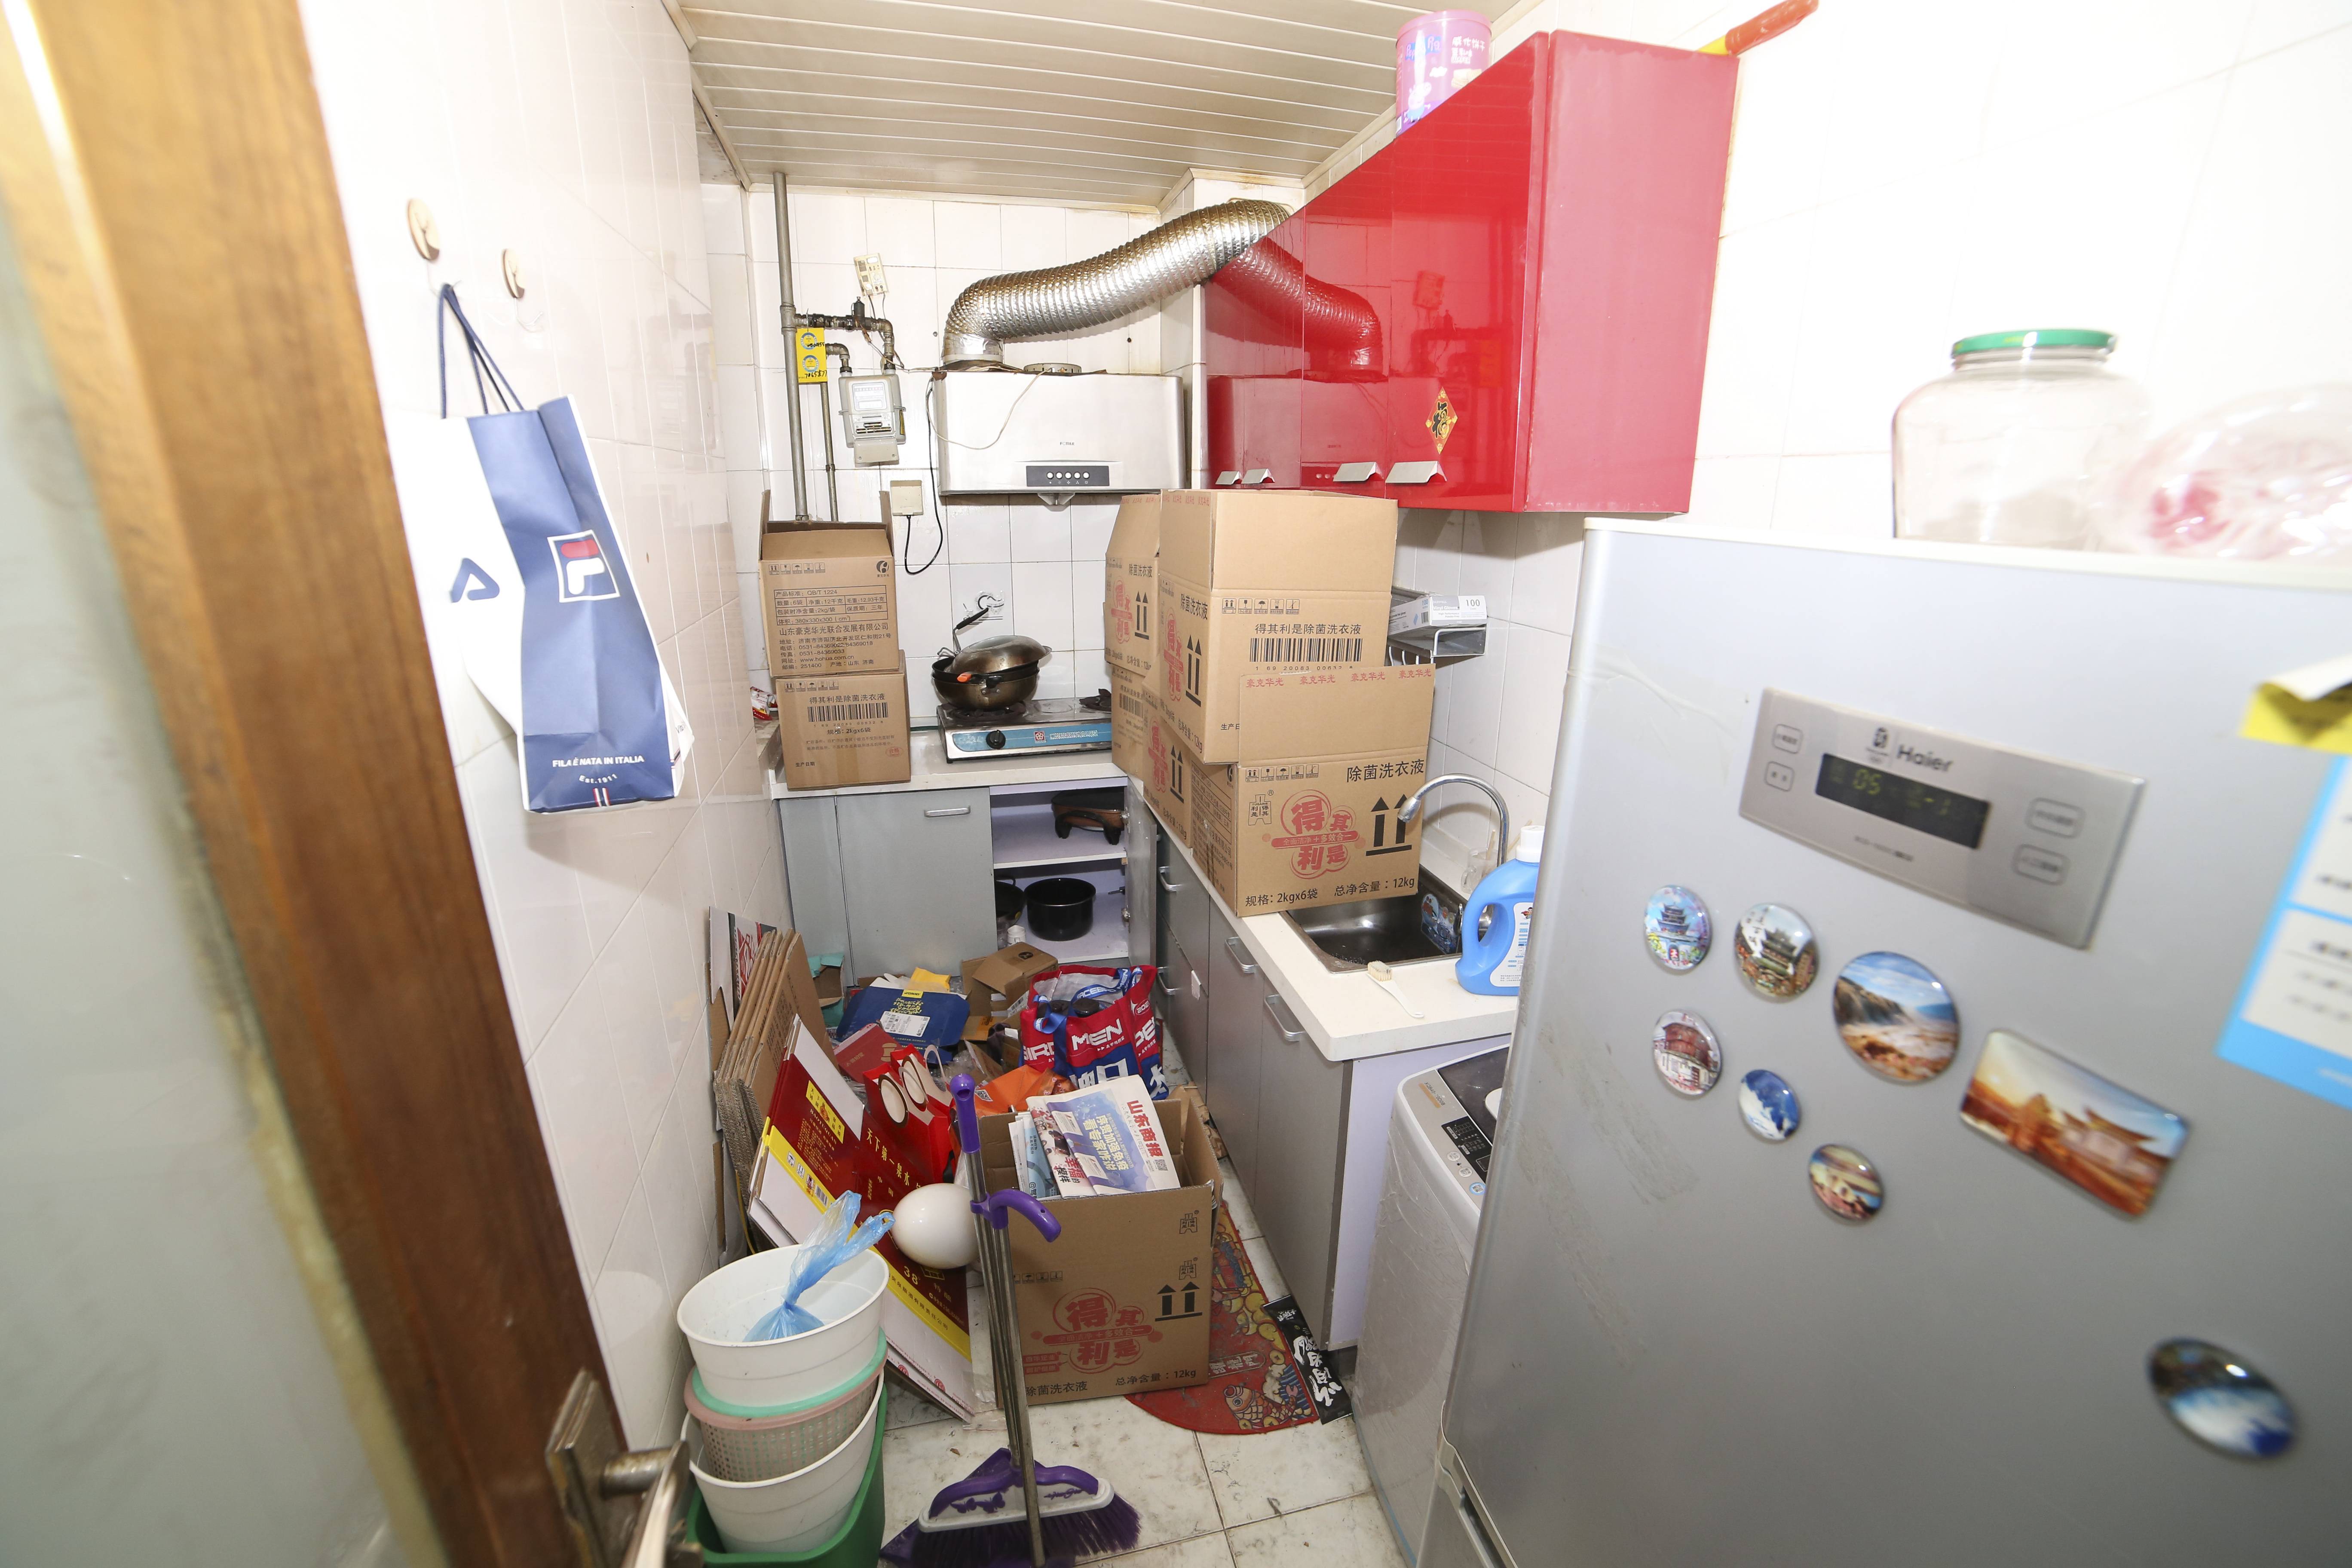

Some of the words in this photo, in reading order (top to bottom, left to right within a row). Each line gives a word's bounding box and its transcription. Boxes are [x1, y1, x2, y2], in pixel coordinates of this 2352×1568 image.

[1129, 564, 1152, 578] 除菌洗衣液
[1181, 594, 1208, 620] 除菌洗衣液
[779, 623, 888, 636] 山东豪克华光联合发展有限公司
[1255, 623, 1362, 635] 得其利是除菌洗衣液
[1246, 678, 1284, 688] 豪克华光
[1299, 674, 1335, 685] 豪克华光
[1351, 671, 1386, 682] 豪克华光
[1399, 668, 1432, 679] 豪克华光
[809, 693, 885, 704] 得其利是除菌洗衣液
[552, 760, 572, 768] FILA
[573, 757, 579, 766] È
[579, 757, 603, 766] NATA
[615, 755, 644, 764] ITALIA
[1896, 744, 1954, 772] Haier
[579, 774, 618, 784] Est.1911
[1347, 759, 1424, 783] 除菌洗衣液
[1072, 1018, 1123, 1051] MEN
[1127, 1100, 1164, 1157] 山东商报
[1082, 1118, 1118, 1171] 看专家咋说
[1096, 1115, 1130, 1171] 序贯加强免疫
[867, 1127, 910, 1186] 天下第一泉水
[1026, 1381, 1087, 1396] 除菌洗衣液
